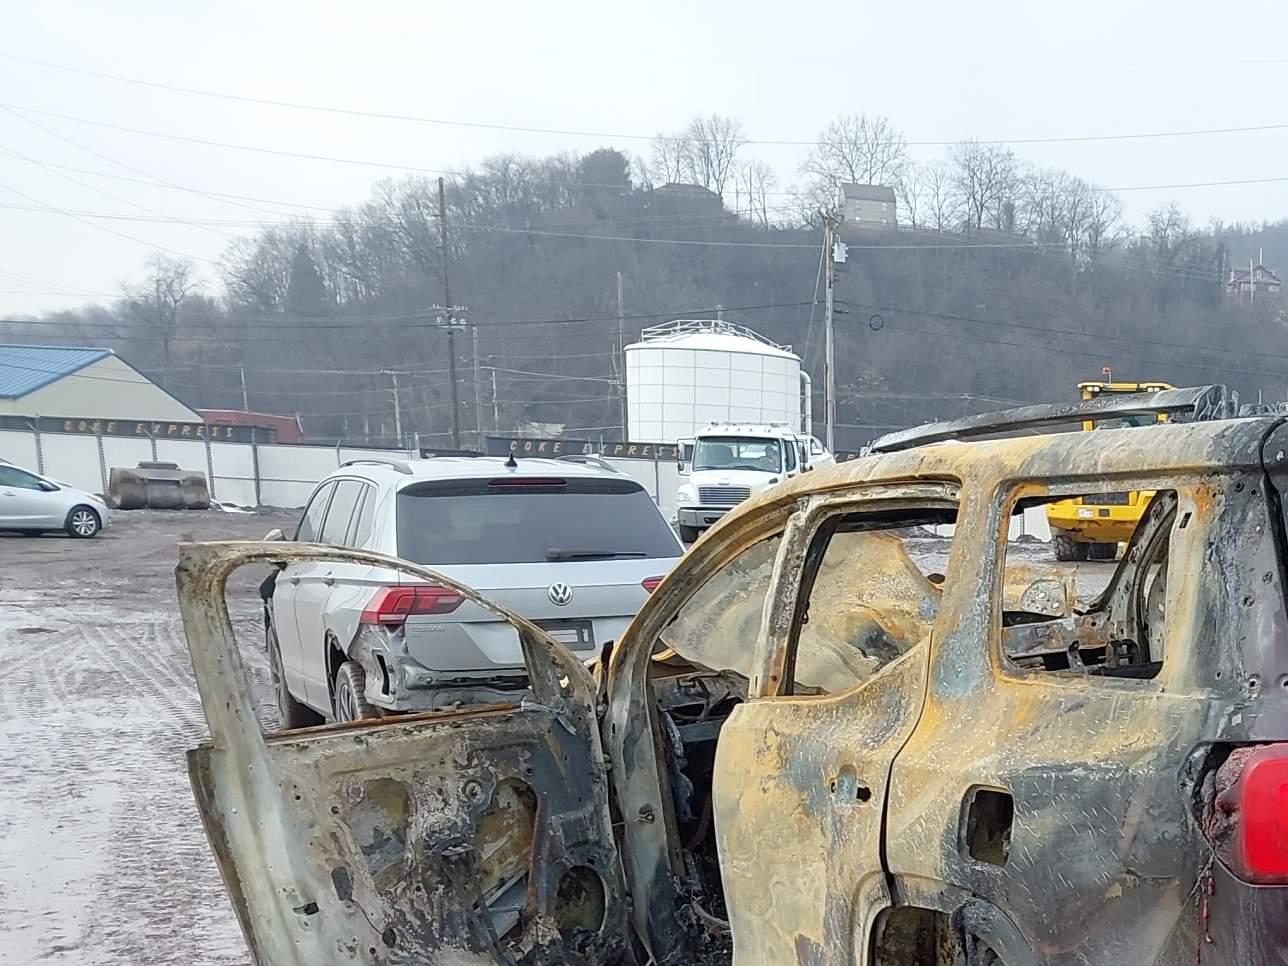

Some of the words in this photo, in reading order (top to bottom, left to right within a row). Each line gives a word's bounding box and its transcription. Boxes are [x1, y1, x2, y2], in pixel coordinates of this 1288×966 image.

[64, 420, 116, 433] COKE
[136, 423, 233, 437] EXPRESS
[509, 440, 561, 453] COKE
[582, 443, 678, 457] EXPRESS
